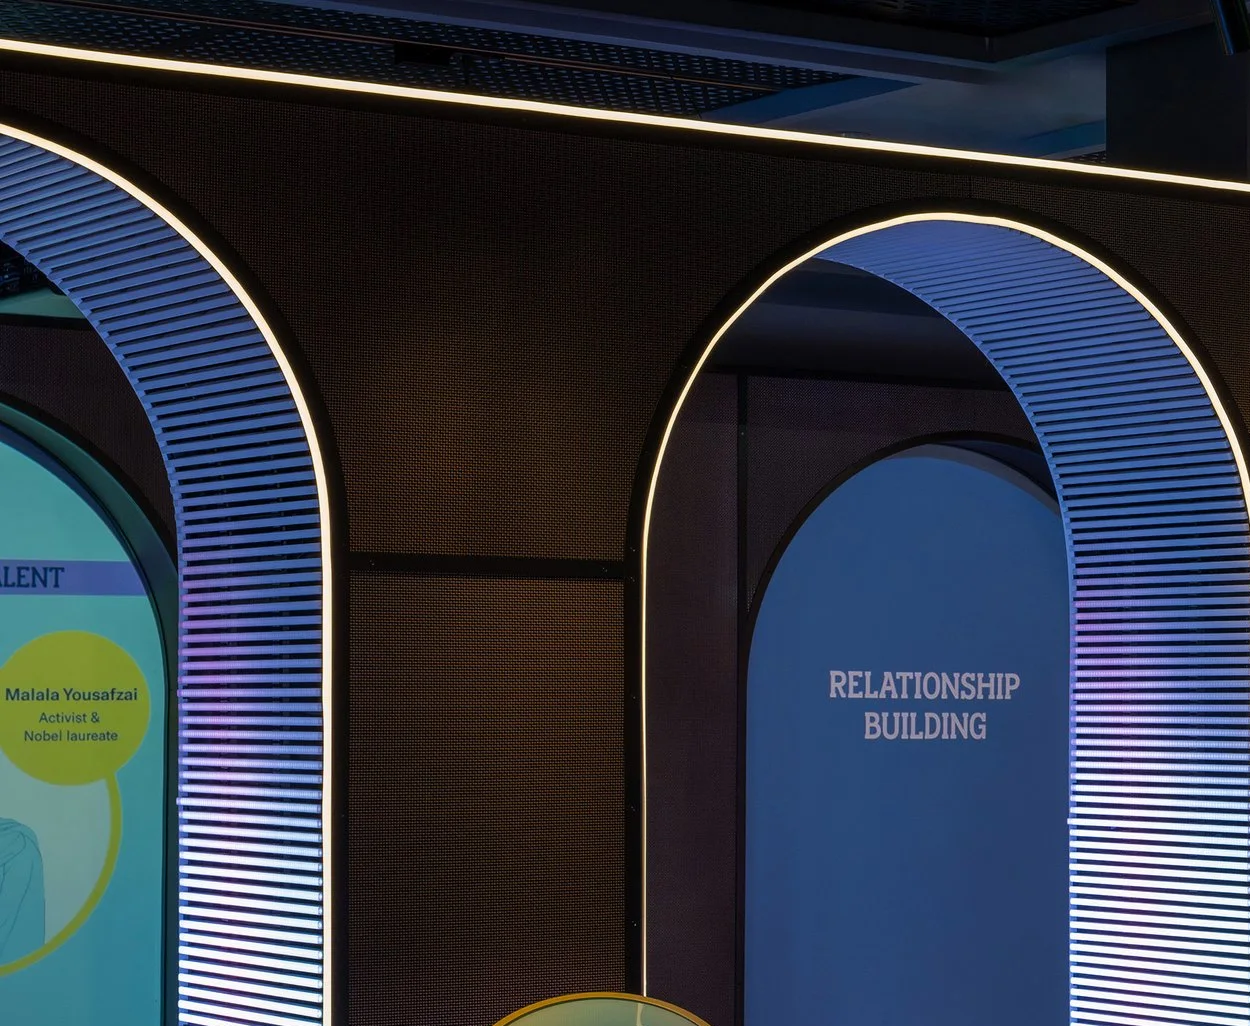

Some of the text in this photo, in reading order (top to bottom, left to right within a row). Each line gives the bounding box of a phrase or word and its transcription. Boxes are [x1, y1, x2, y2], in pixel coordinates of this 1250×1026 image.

[0, 566, 65, 588] LENT
[829, 670, 1021, 700] RELATIONSHIP
[5, 688, 138, 701] Malala Yousafzai
[39, 712, 100, 723] Activist &
[864, 711, 987, 740] BUILDING
[24, 730, 118, 741] Nobel laureate
